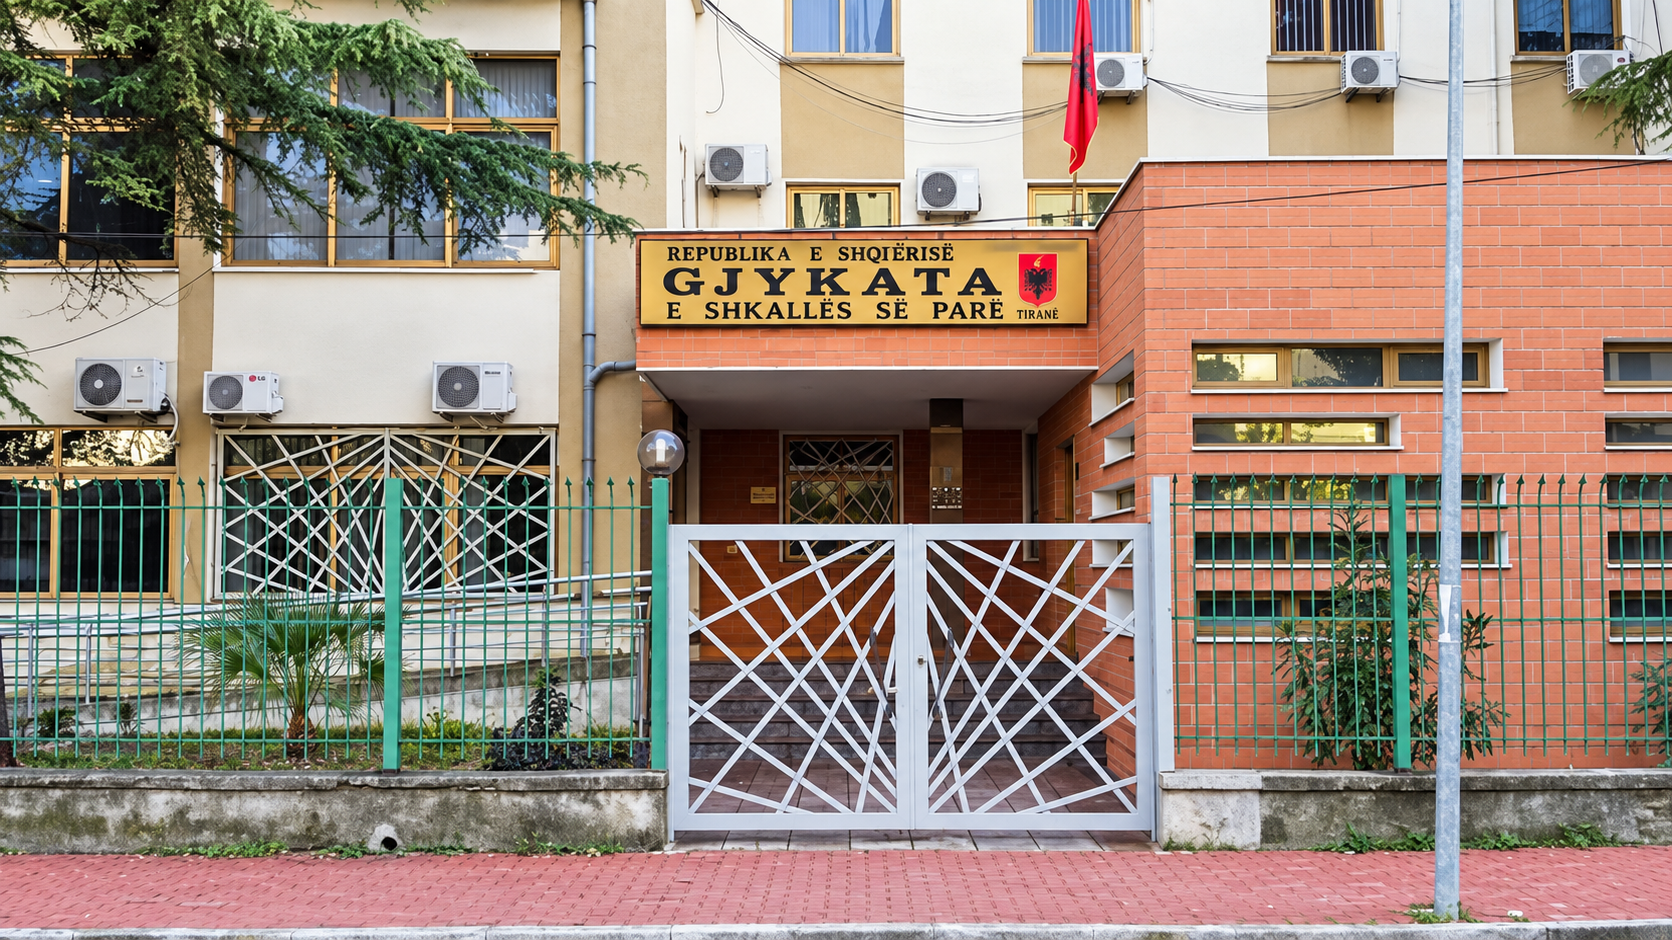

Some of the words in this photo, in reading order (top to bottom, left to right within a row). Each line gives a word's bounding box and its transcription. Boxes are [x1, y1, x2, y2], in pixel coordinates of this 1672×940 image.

[667, 246, 791, 261] REPUBLIKA
[810, 246, 822, 261] E
[663, 267, 1002, 296] GJYKATA
[667, 301, 681, 319] E
[705, 298, 852, 320] SHKALLËS
[876, 298, 908, 320] SË
[932, 298, 1004, 320] PARË
